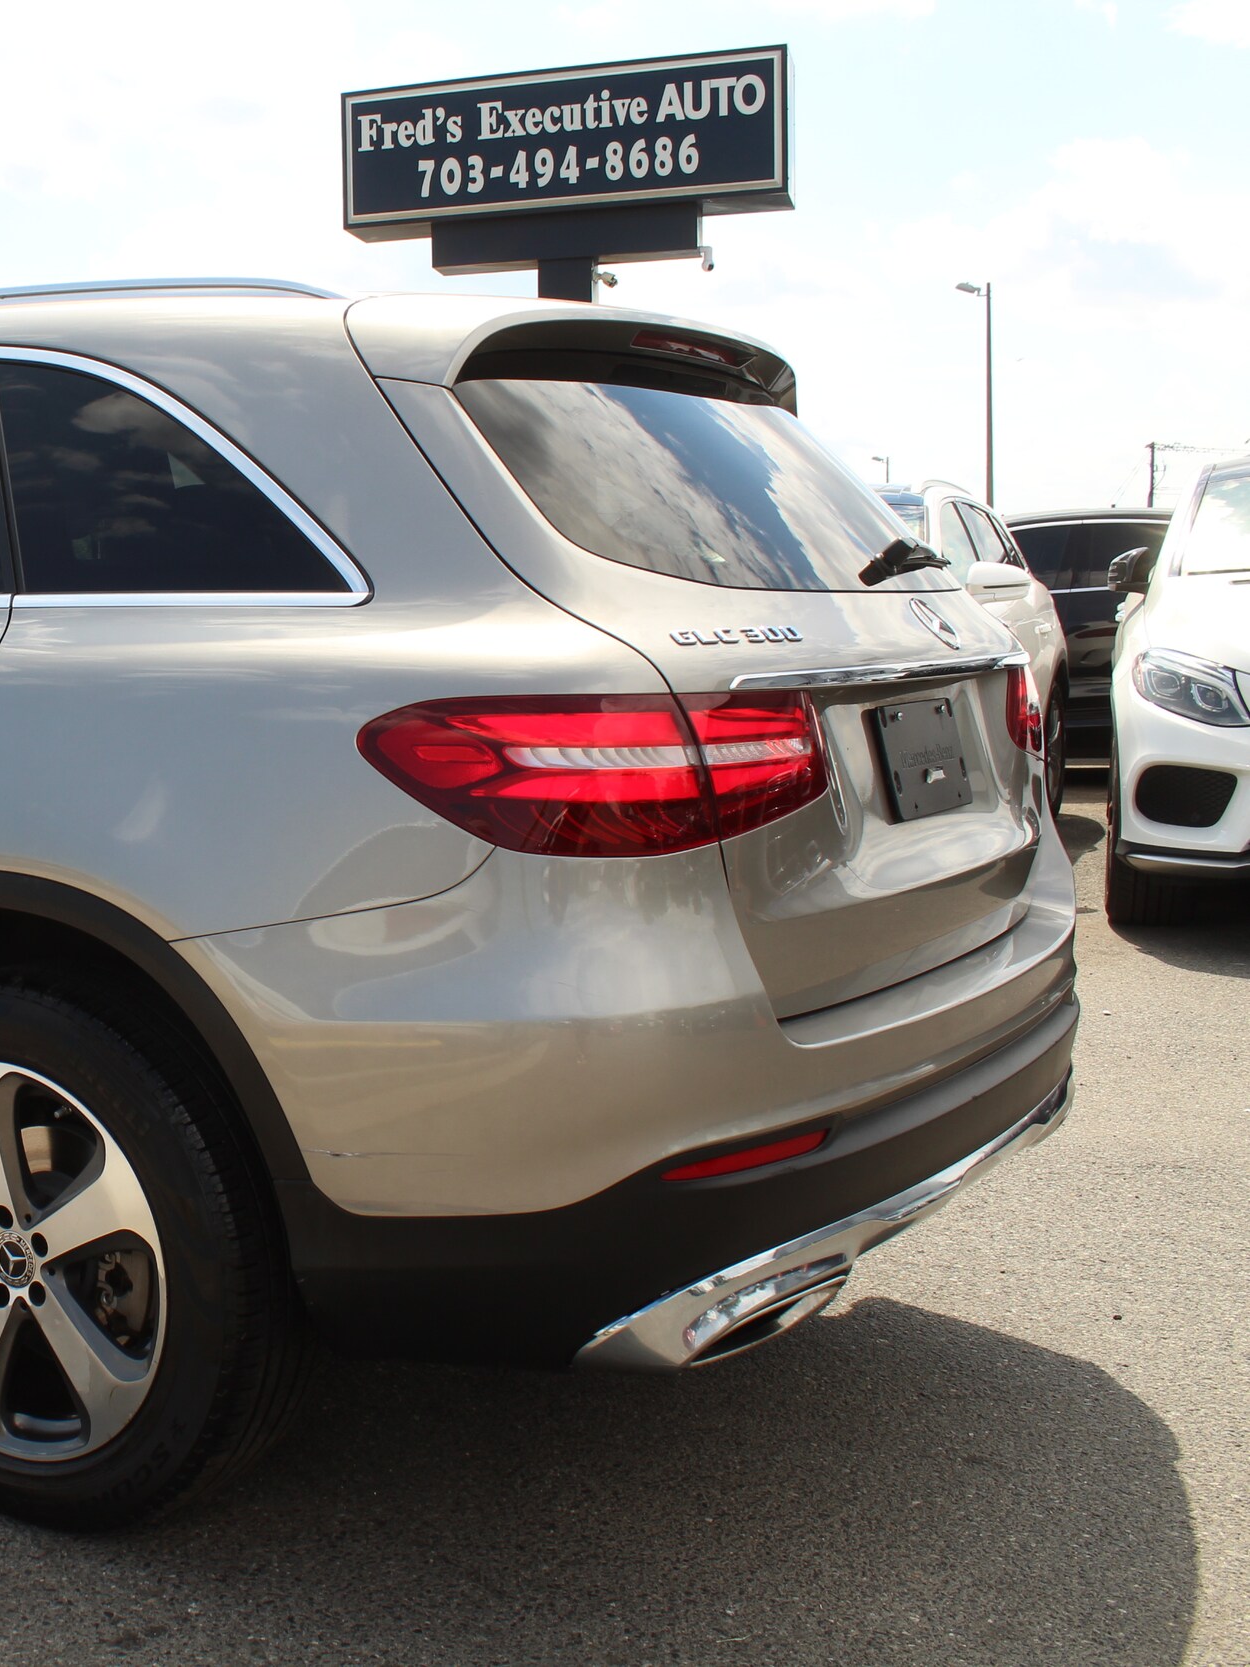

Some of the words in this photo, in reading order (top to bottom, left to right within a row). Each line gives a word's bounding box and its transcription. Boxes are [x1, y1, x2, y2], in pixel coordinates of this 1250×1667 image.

[357, 108, 463, 152] Fred's
[477, 90, 649, 141] Executive
[655, 74, 766, 122] AUTO
[417, 133, 700, 198] 703-494-8686
[669, 628, 739, 645] GLC
[740, 625, 803, 643] 300
